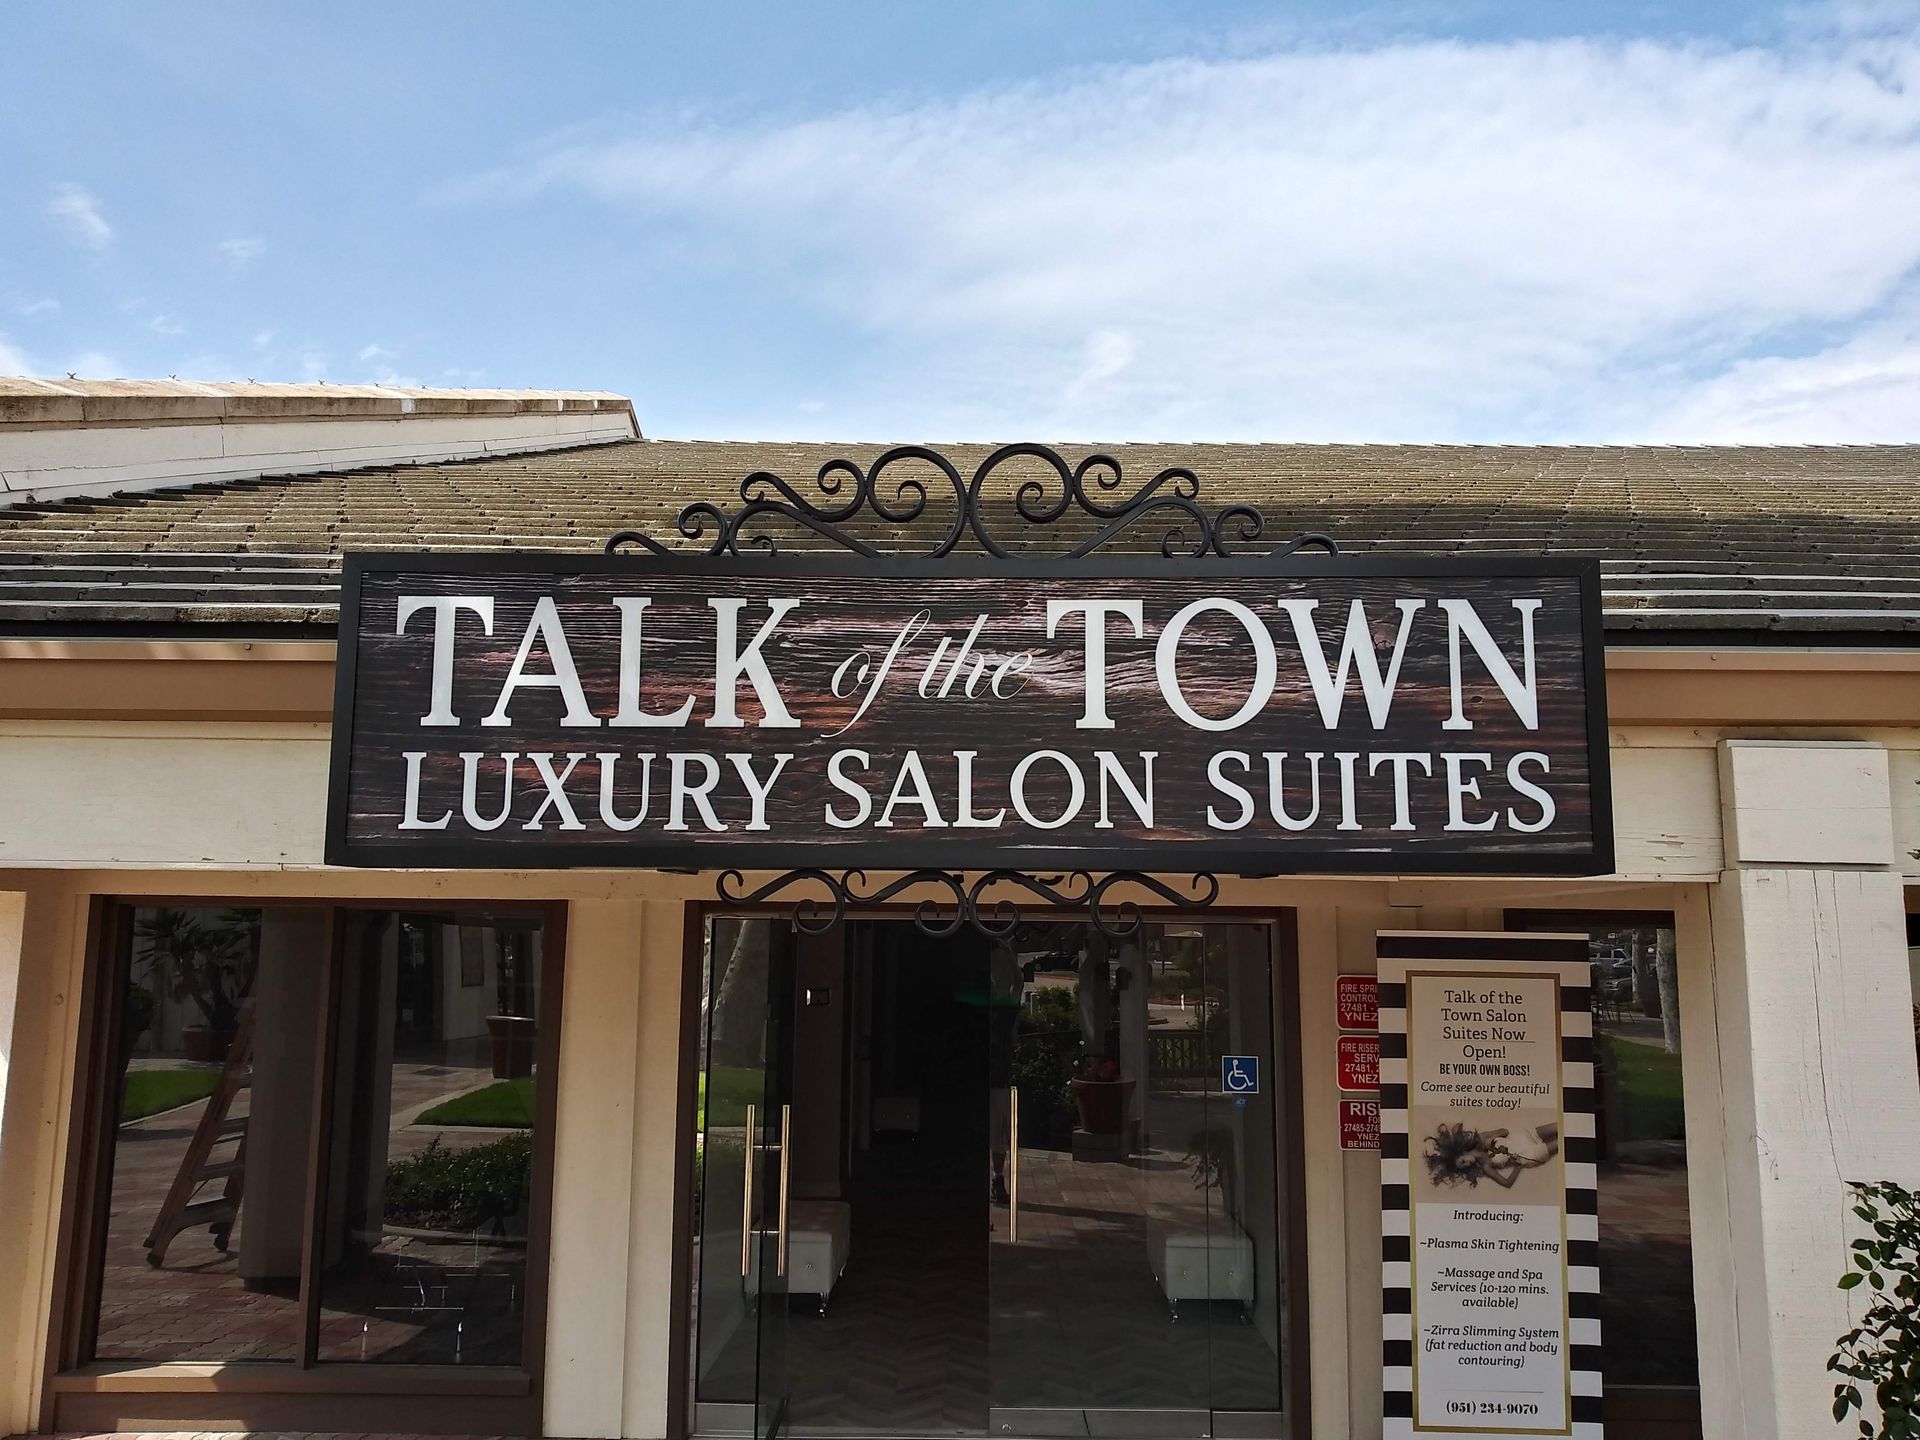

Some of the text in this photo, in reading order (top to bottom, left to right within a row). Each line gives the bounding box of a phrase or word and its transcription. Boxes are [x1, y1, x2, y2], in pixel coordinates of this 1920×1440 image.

[396, 595, 1543, 738] TALK of the TOWN
[398, 750, 1556, 833] LUXURY SALON SUITES
[1341, 984, 1378, 993] FIRE SPRI
[1341, 994, 1378, 1002] CONTROL
[1444, 990, 1523, 1004] Talk of the
[1341, 1003, 1367, 1012] 27481
[1344, 1013, 1378, 1021] YNEZ
[1441, 1008, 1527, 1022] Town Salon
[1443, 1027, 1526, 1041] Suites Now
[1341, 1043, 1380, 1053] FIRE RISER
[1463, 1045, 1506, 1061] Open!
[1354, 1054, 1380, 1063] SERV
[1345, 1064, 1374, 1074] 27481,
[1440, 1063, 1530, 1077] BE YOUR OWN BOSS!
[1351, 1074, 1378, 1084] YNEZ
[1421, 1081, 1550, 1096] Come see our beautiful
[1450, 1096, 1521, 1109] suites today!
[1453, 1210, 1524, 1224] Introducing:
[1420, 1238, 1560, 1254] ~Plasma Skin Tightening
[1437, 1268, 1543, 1281] ~Massage and Spa
[1431, 1282, 1549, 1295] Services (10-120 mins.
[1462, 1297, 1519, 1310] available)
[1462, 1326, 1516, 1340] Slimming
[1518, 1327, 1559, 1340] System
[1425, 1339, 1558, 1355] (fat reduction and body
[1458, 1355, 1525, 1369] contouring)
[1446, 1400, 1539, 1415] (951) 234-9070
